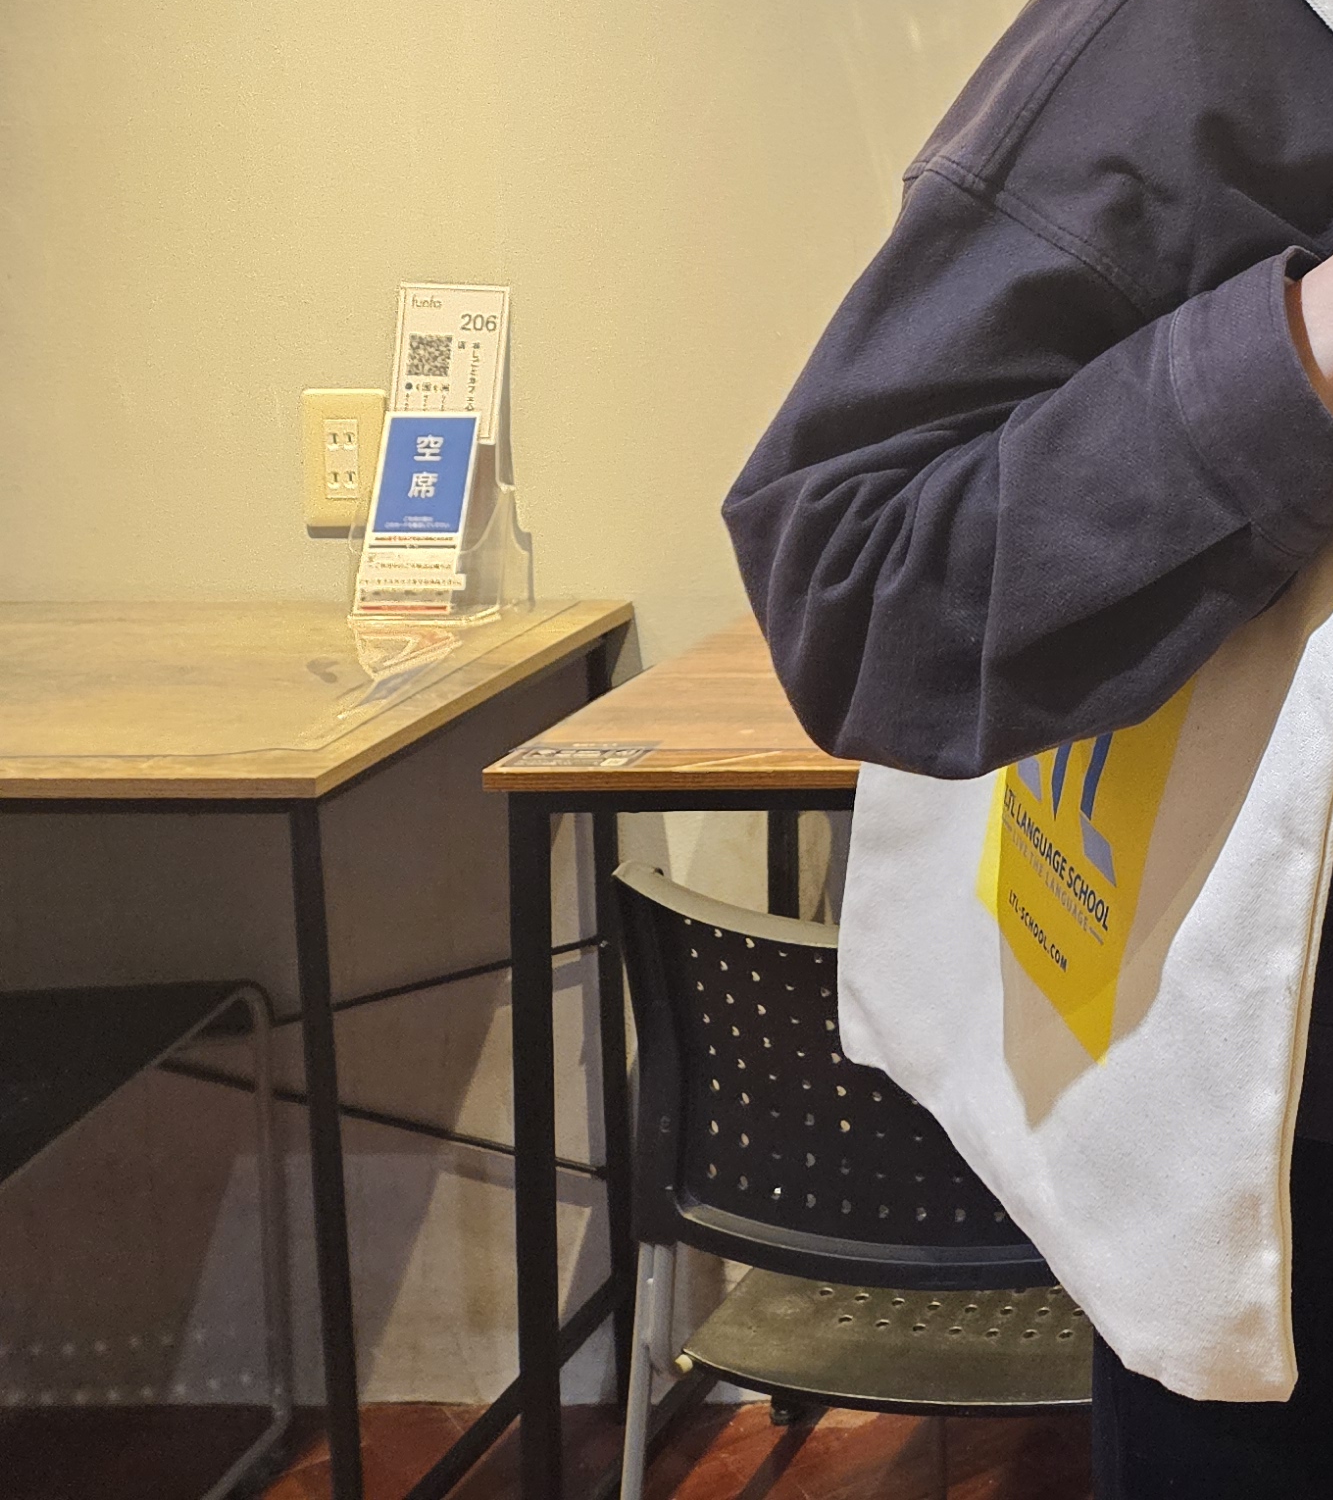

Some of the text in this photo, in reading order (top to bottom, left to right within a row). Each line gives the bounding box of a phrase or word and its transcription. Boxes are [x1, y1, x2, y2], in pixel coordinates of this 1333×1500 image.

[460, 313, 498, 332] 206
[408, 434, 444, 498] 空席
[1003, 783, 1016, 818] LTL
[1016, 803, 1067, 880] LANGUAGE
[1067, 866, 1110, 931] SCHOOL
[1009, 889, 1067, 973] LTL-SCHOOL.COM
[1045, 871, 1090, 932] LANGUAGE
